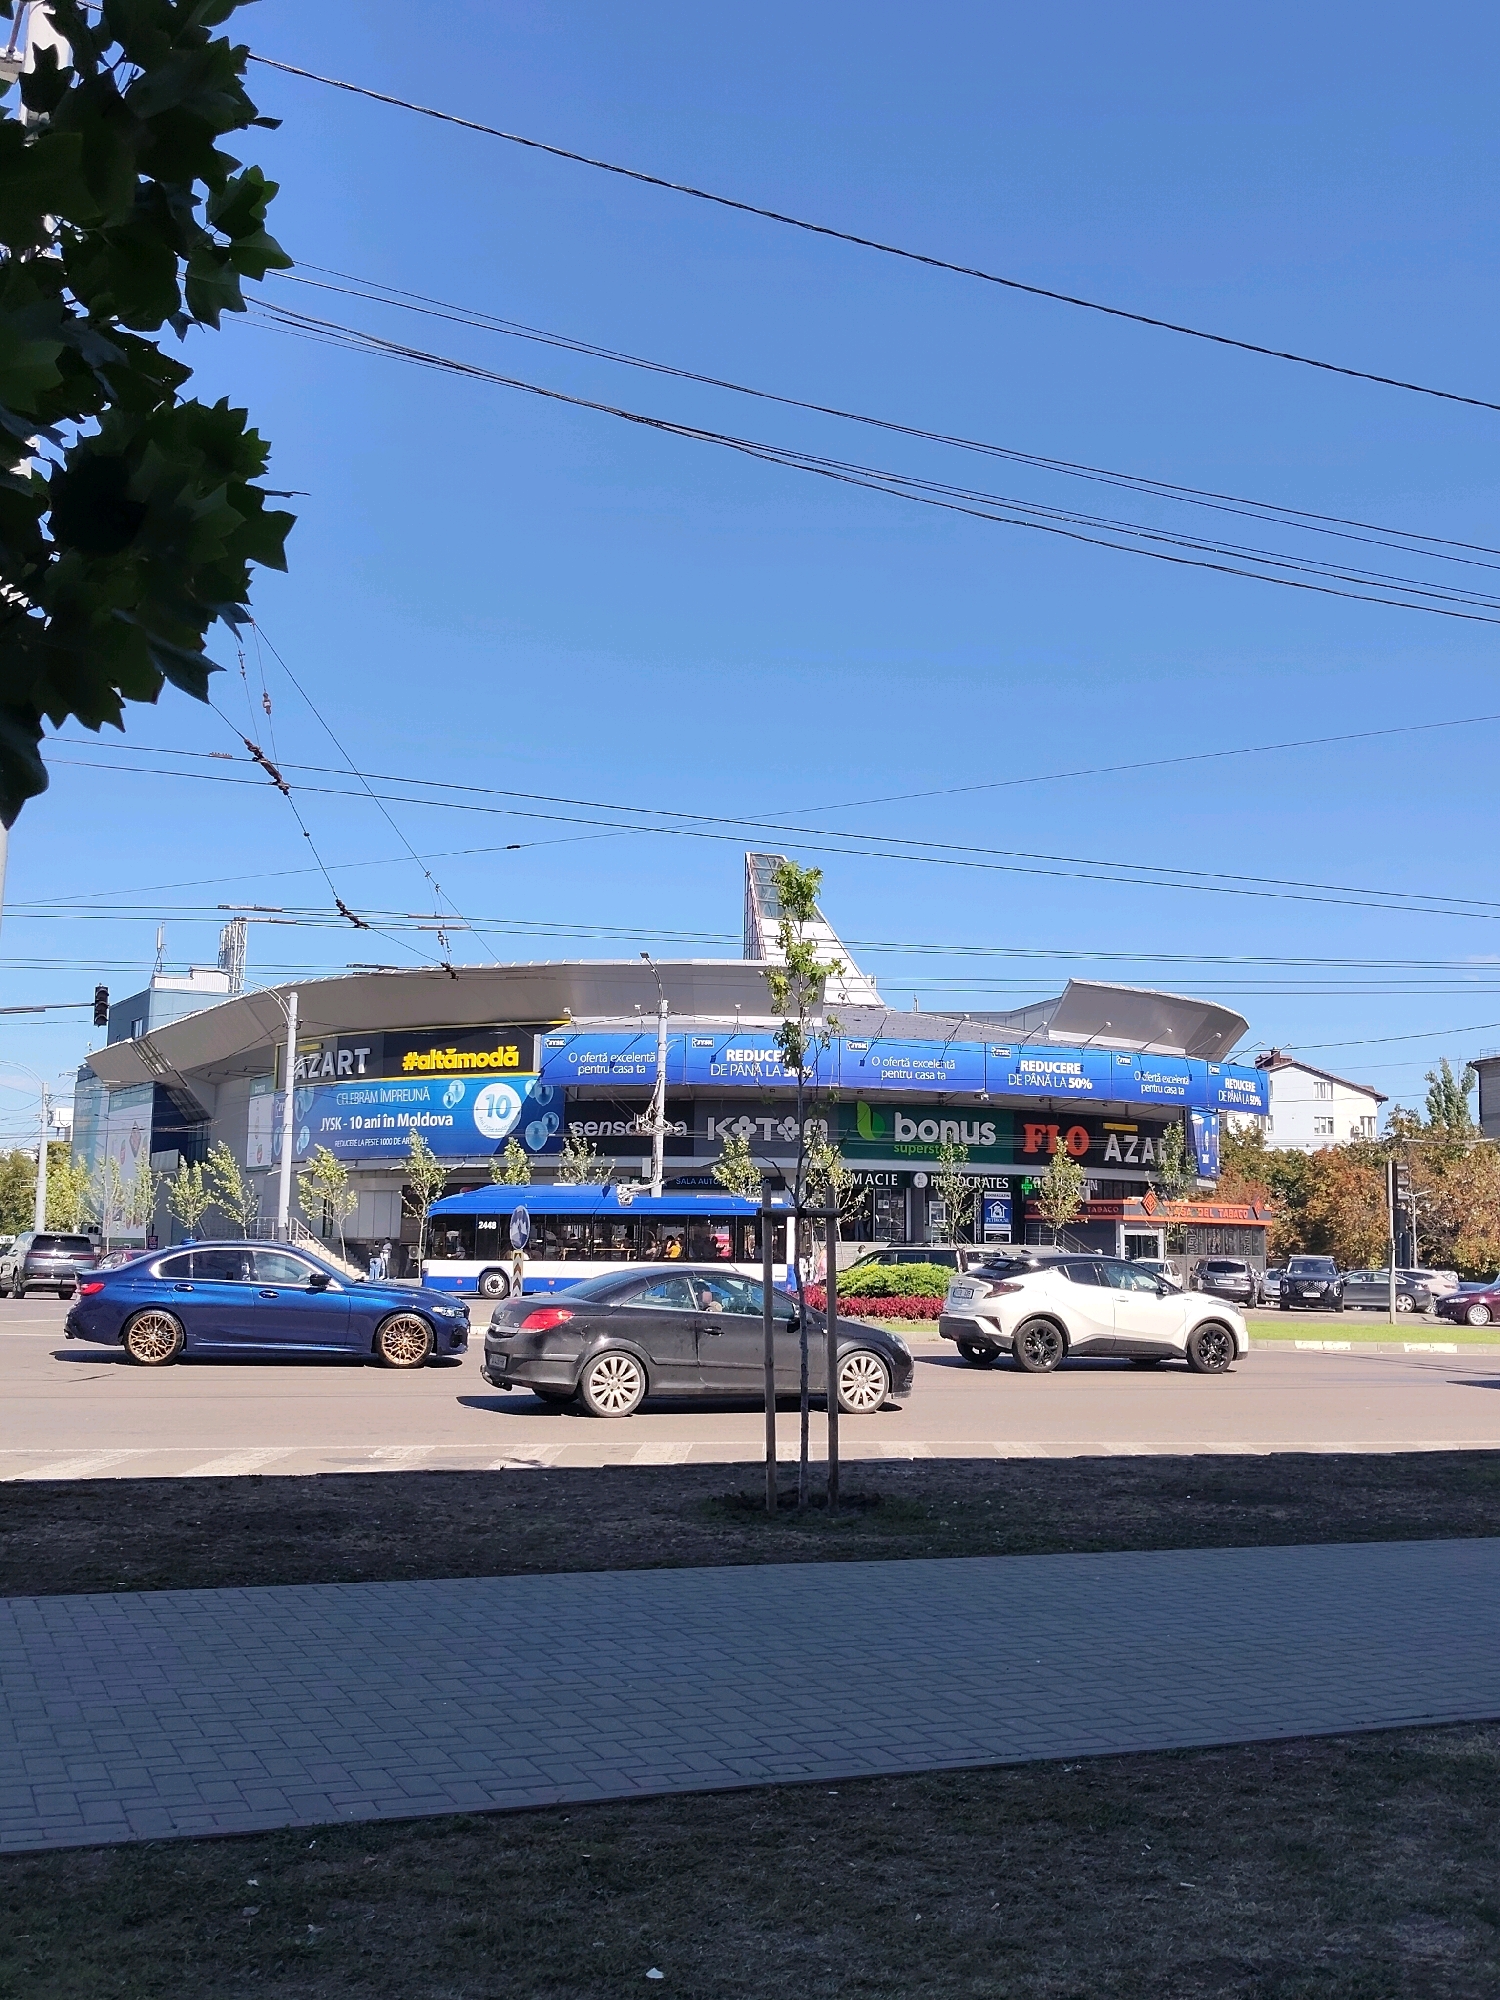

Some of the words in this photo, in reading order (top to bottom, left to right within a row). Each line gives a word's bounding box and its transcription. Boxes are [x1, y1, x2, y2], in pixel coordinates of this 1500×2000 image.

[295, 1048, 371, 1080] AZART
[402, 1045, 519, 1071] #altămodă
[568, 1052, 578, 1063] O
[580, 1051, 608, 1063] ofertă
[871, 1056, 881, 1067] O
[882, 1056, 910, 1068] ofertă
[578, 1065, 610, 1076] pentru
[612, 1065, 633, 1074] casa
[636, 1064, 646, 1074] ta
[710, 1063, 728, 1076] DE
[766, 1064, 781, 1077] LA
[880, 1069, 913, 1081] pentru
[915, 1070, 935, 1080] casa
[937, 1070, 946, 1080] ta
[1020, 1059, 1082, 1075] REDUCERE
[1008, 1073, 1023, 1086] DE
[1024, 1072, 1053, 1087] PÂNĂ
[1054, 1075, 1067, 1088] LA
[1068, 1077, 1093, 1090] 50%
[1133, 1070, 1141, 1081] O
[1141, 1084, 1163, 1094] pentru
[1164, 1085, 1178, 1095] casa
[1178, 1086, 1185, 1095] ta
[1224, 1077, 1256, 1093] REDUCERE
[380, 1086, 431, 1103] ÎMPREUNĂ
[1218, 1089, 1228, 1102] DE
[1242, 1093, 1250, 1105] LA
[485, 1093, 512, 1120] 10
[319, 1116, 343, 1132] JYSK
[349, 1115, 363, 1130] 10
[364, 1113, 381, 1129] ani
[383, 1112, 395, 1128] în
[397, 1111, 454, 1127] Moldova
[894, 1111, 997, 1146] bonus
[393, 1137, 401, 1146] DE
[1218, 1208, 1249, 1219] TABACO
